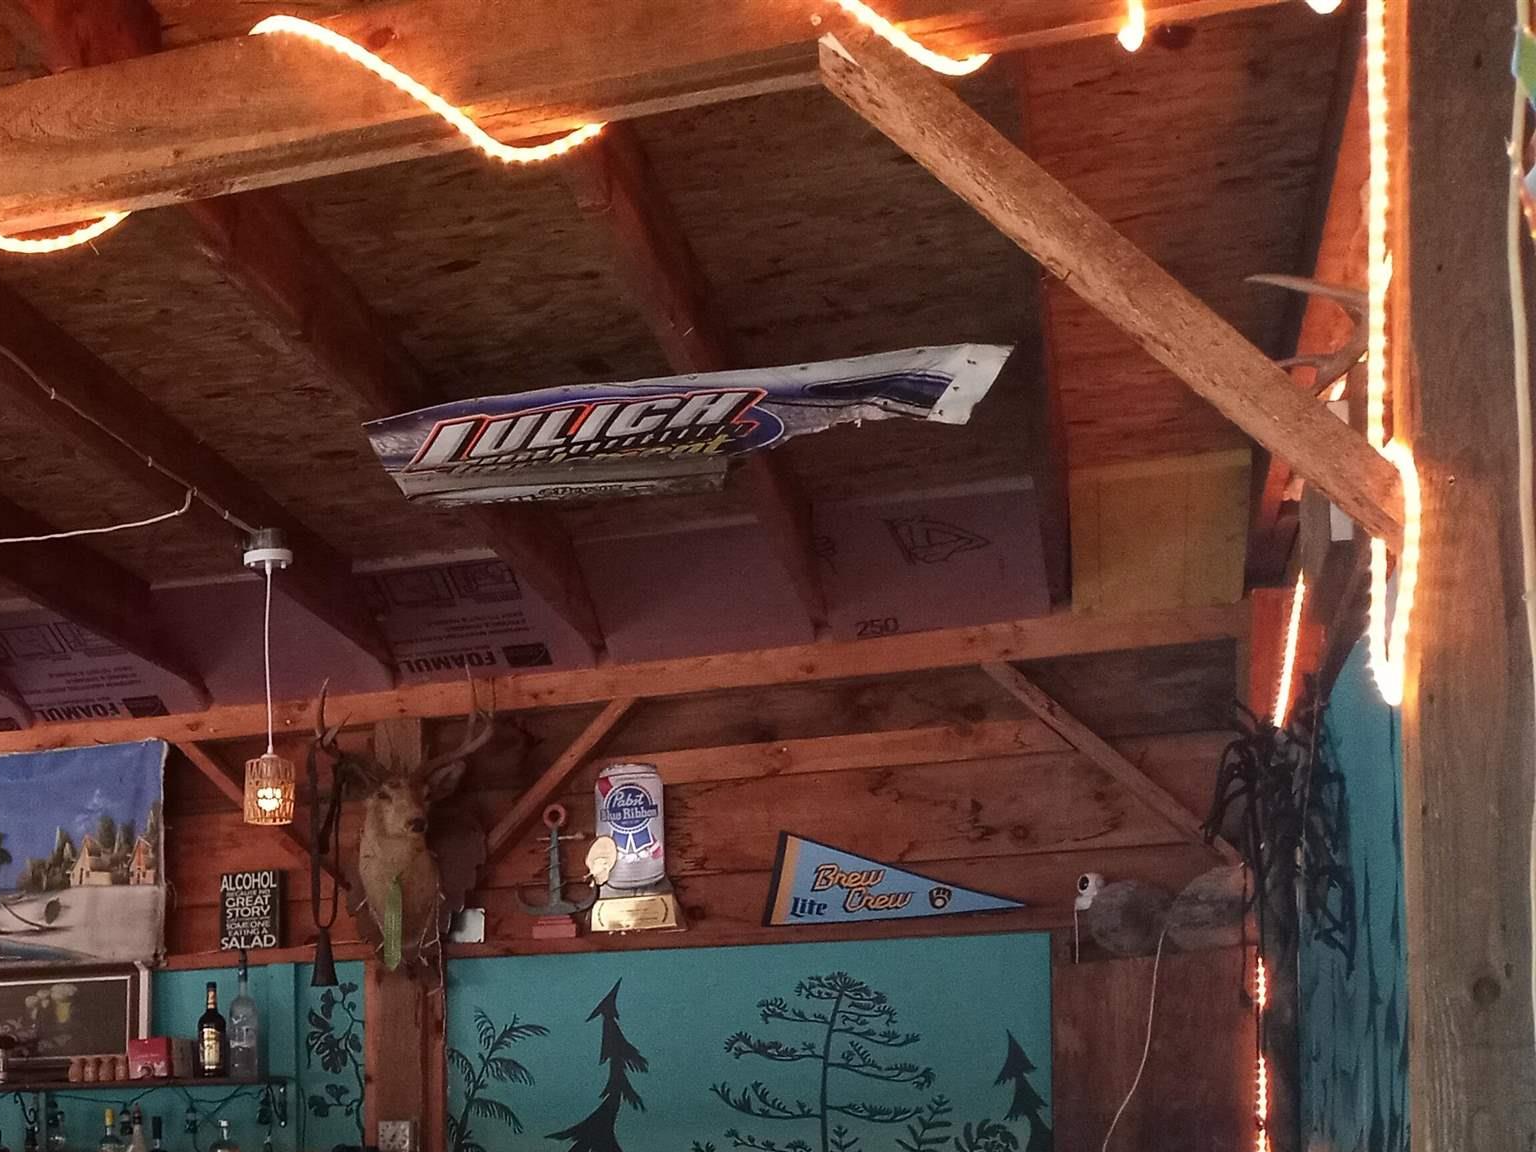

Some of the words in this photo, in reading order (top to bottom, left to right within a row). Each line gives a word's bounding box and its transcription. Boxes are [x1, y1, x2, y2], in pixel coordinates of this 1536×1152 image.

[855, 617, 899, 640] 250
[612, 791, 645, 808] Pabst
[622, 806, 658, 820] Ribbon
[220, 871, 277, 892] ALCOHOL
[813, 863, 887, 892] Brew
[225, 895, 272, 908] GREAT
[790, 896, 828, 917] Lite
[842, 886, 914, 913] Crew
[226, 905, 271, 919] STORY
[220, 934, 276, 950] SALAD
